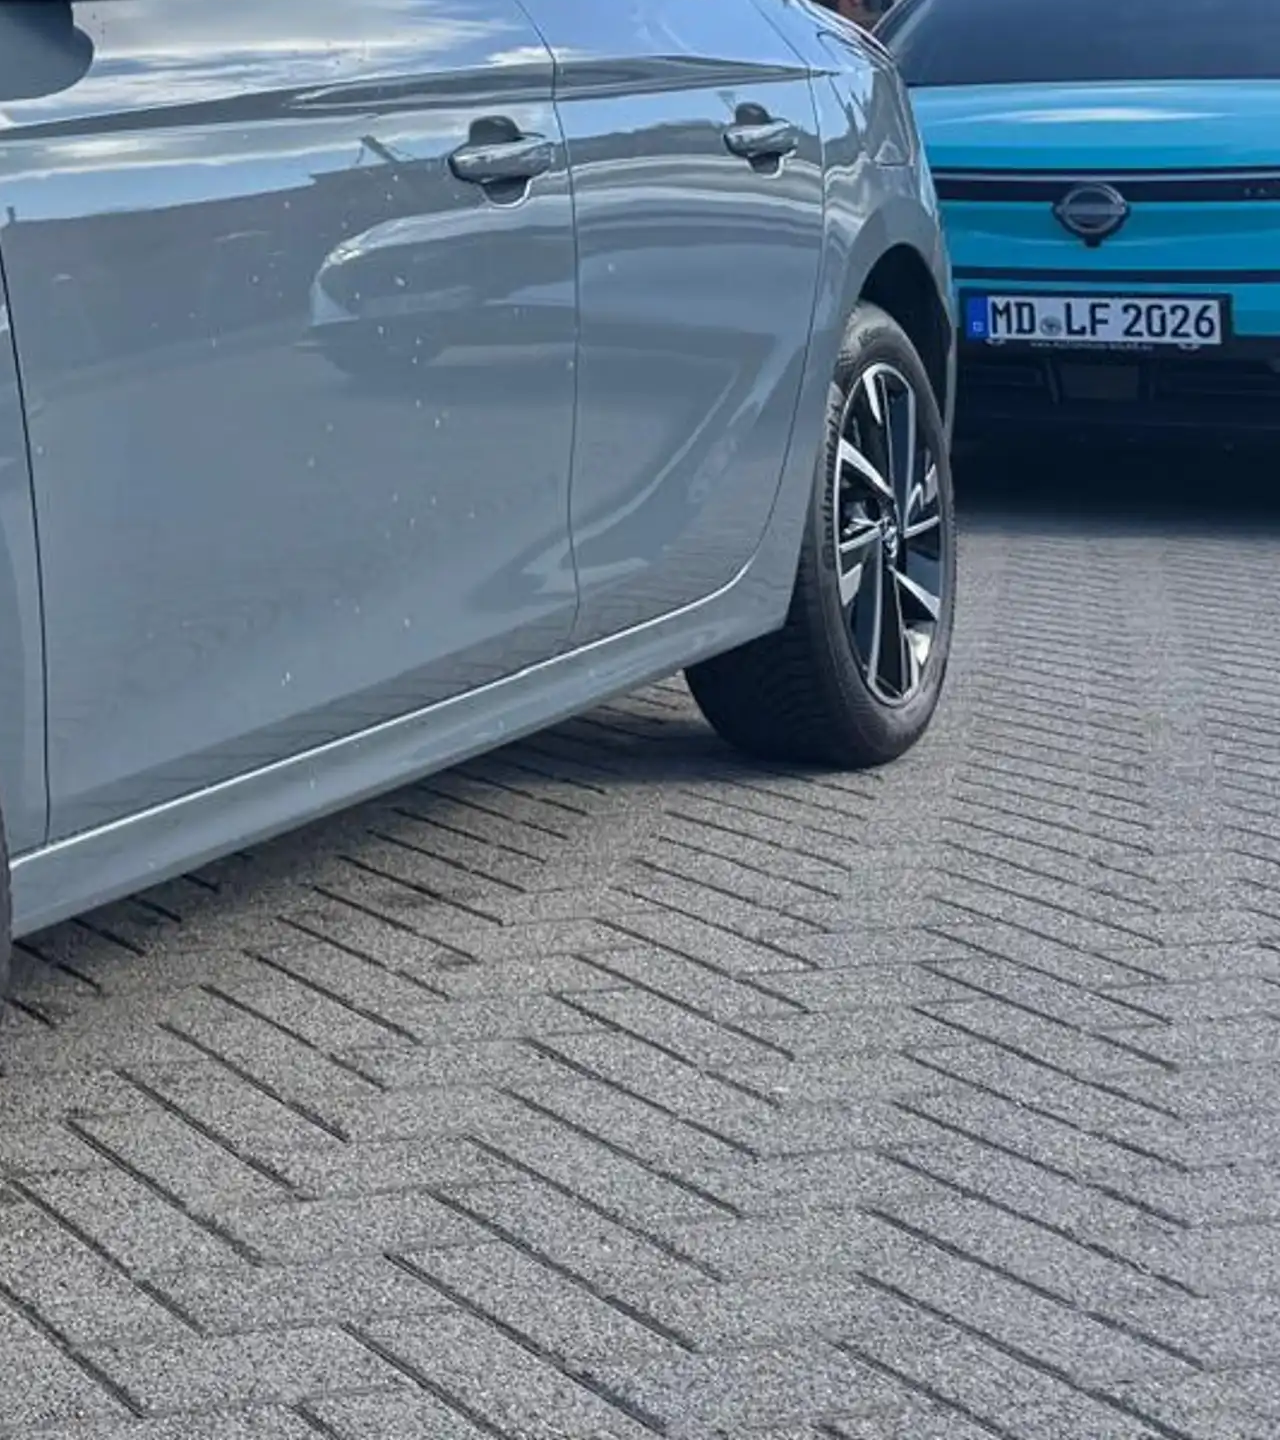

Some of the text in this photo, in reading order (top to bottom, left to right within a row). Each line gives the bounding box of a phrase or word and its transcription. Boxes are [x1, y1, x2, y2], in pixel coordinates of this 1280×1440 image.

[991, 300, 1216, 339] MD LF 2026
